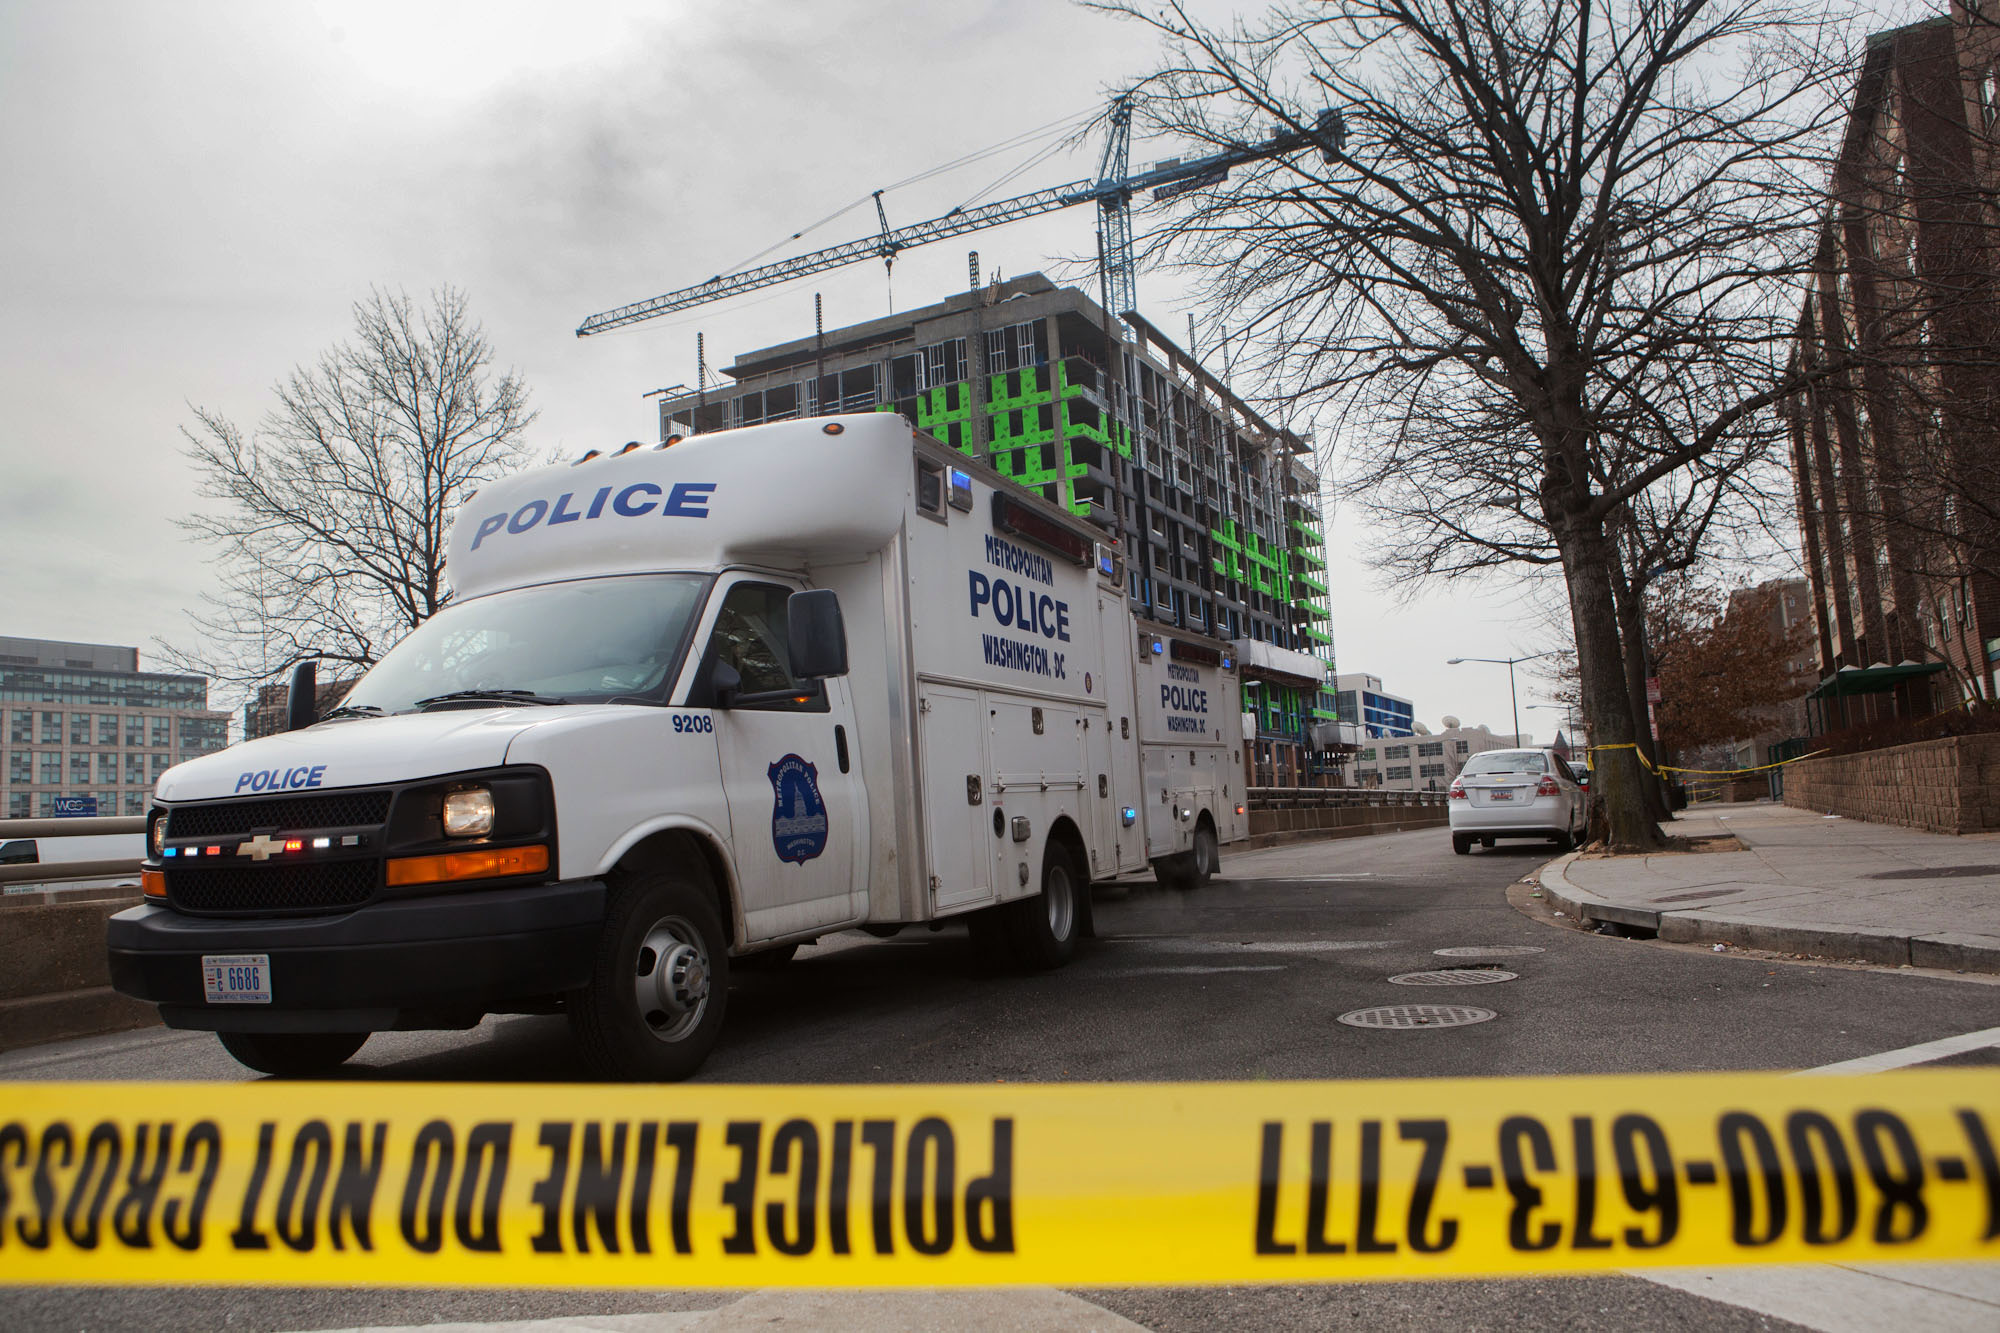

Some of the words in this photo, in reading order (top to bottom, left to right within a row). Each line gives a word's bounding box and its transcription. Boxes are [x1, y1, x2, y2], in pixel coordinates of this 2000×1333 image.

[471, 483, 718, 551] POLICE
[985, 534, 1054, 587] METROPOLITAN
[968, 569, 1071, 643] POLICE
[982, 633, 1052, 678] WASHINGTON,
[1054, 651, 1066, 680] DC
[1167, 663, 1199, 684] METROPOLITAN
[1161, 684, 1208, 713] POLICE
[672, 714, 713, 733] 9208
[1199, 718, 1206, 734] DC
[234, 765, 328, 793] POLICE
[776, 761, 803, 807] METROPOLITAN
[804, 770, 820, 805] POLICE
[229, 966, 260, 991] 6686
[230, 1119, 389, 1253] NOT
[401, 1119, 515, 1254] DO
[531, 1120, 700, 1255] LINE
[721, 1116, 1016, 1256] POLICE
